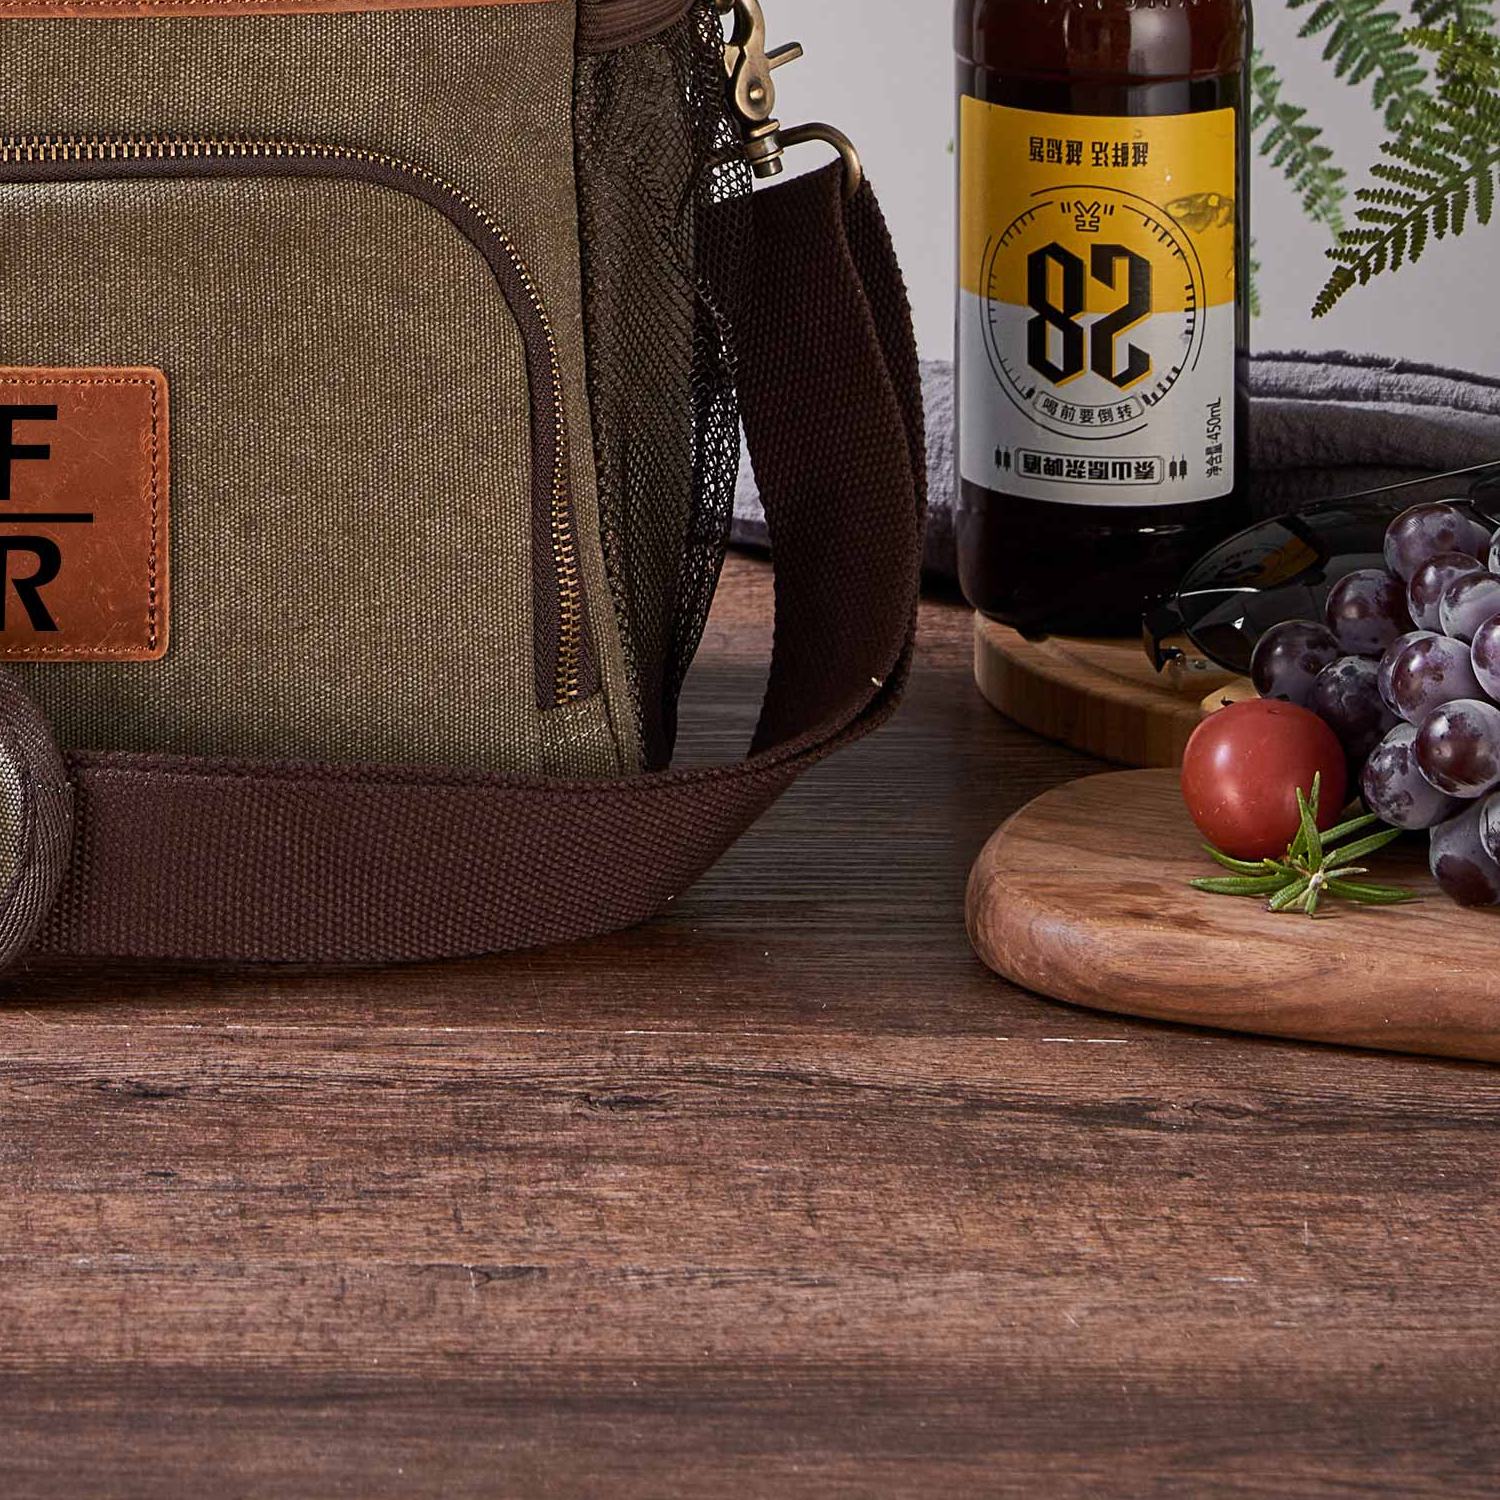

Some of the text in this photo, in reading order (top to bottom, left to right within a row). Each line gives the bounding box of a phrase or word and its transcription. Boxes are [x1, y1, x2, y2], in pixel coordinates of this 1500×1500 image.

[1029, 136, 1149, 168] 越鲜活 越短暂
[1042, 397, 1134, 425] 喝前要倒转
[1023, 454, 1155, 481] 泰山原浆啤酒
